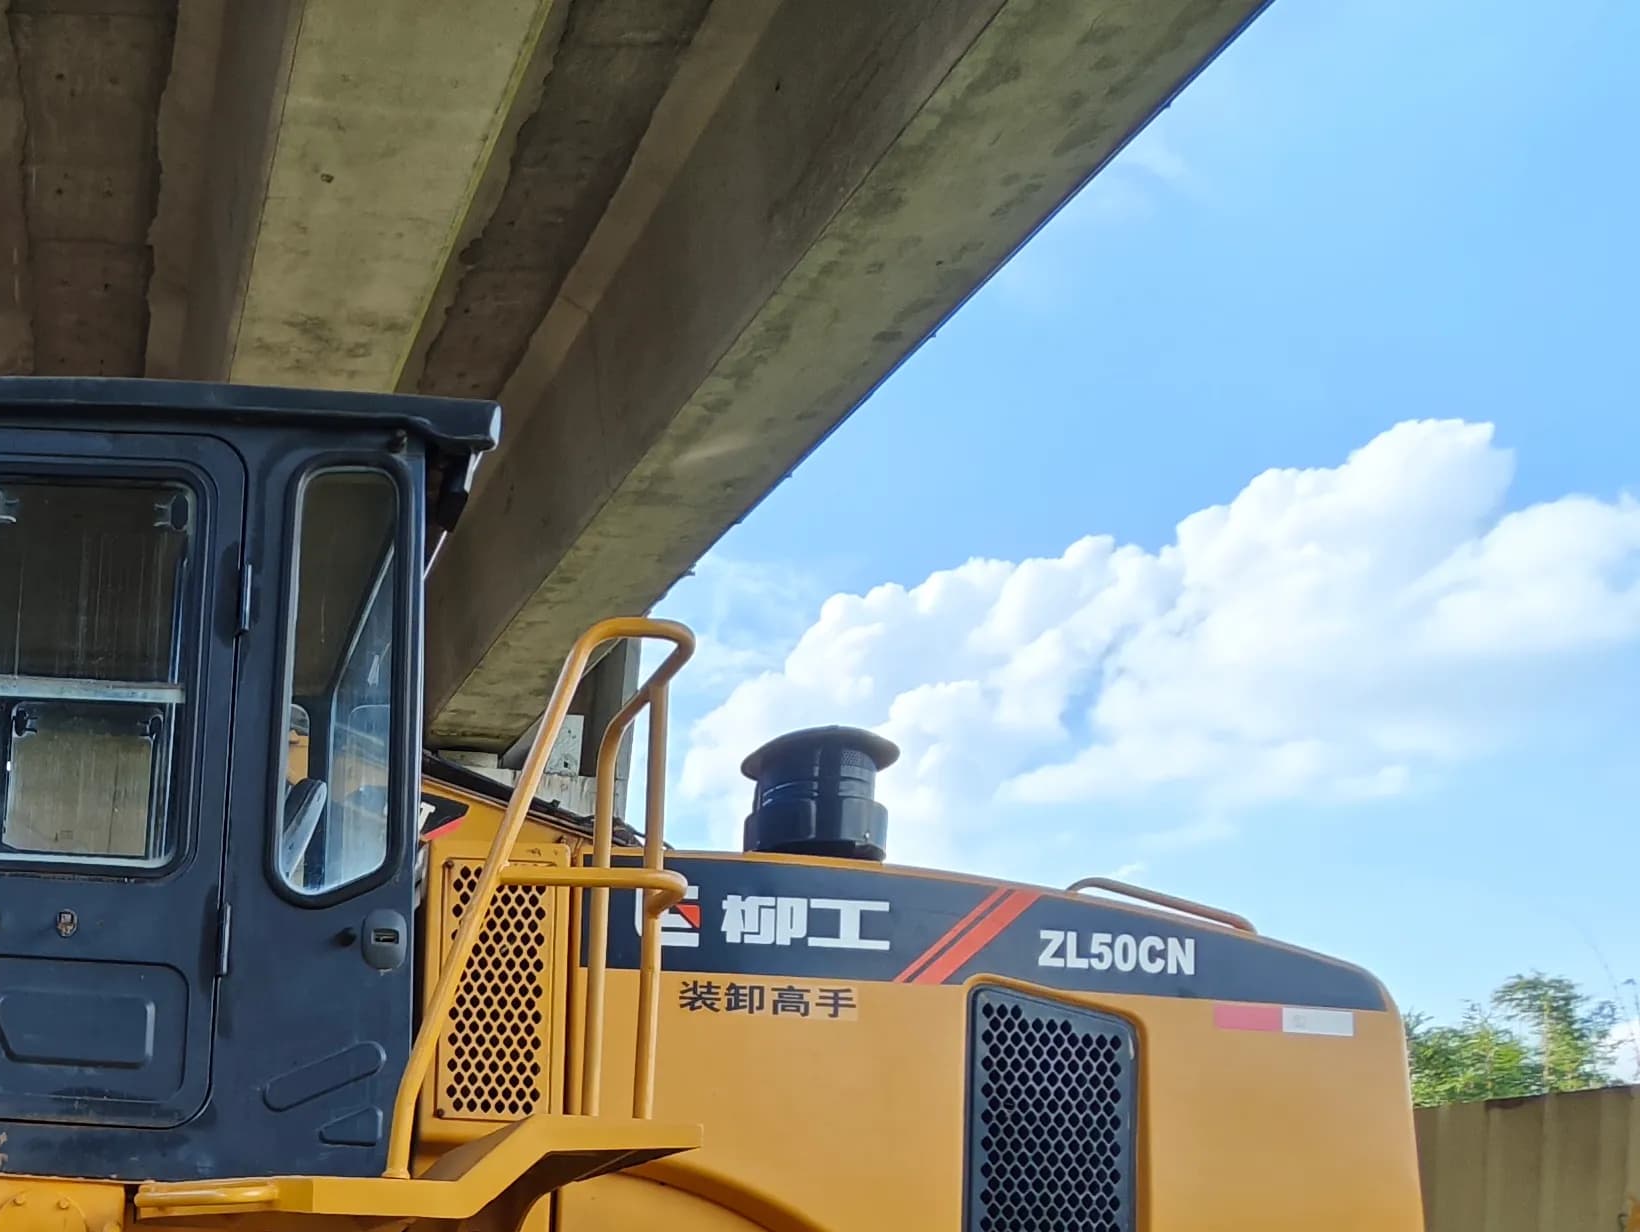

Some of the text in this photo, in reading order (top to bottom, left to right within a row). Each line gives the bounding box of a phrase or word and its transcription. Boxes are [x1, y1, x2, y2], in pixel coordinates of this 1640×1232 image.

[721, 894, 891, 950] 柳工
[1037, 929, 1196, 976] ZL50CN
[678, 980, 857, 1018] 装卸高手
